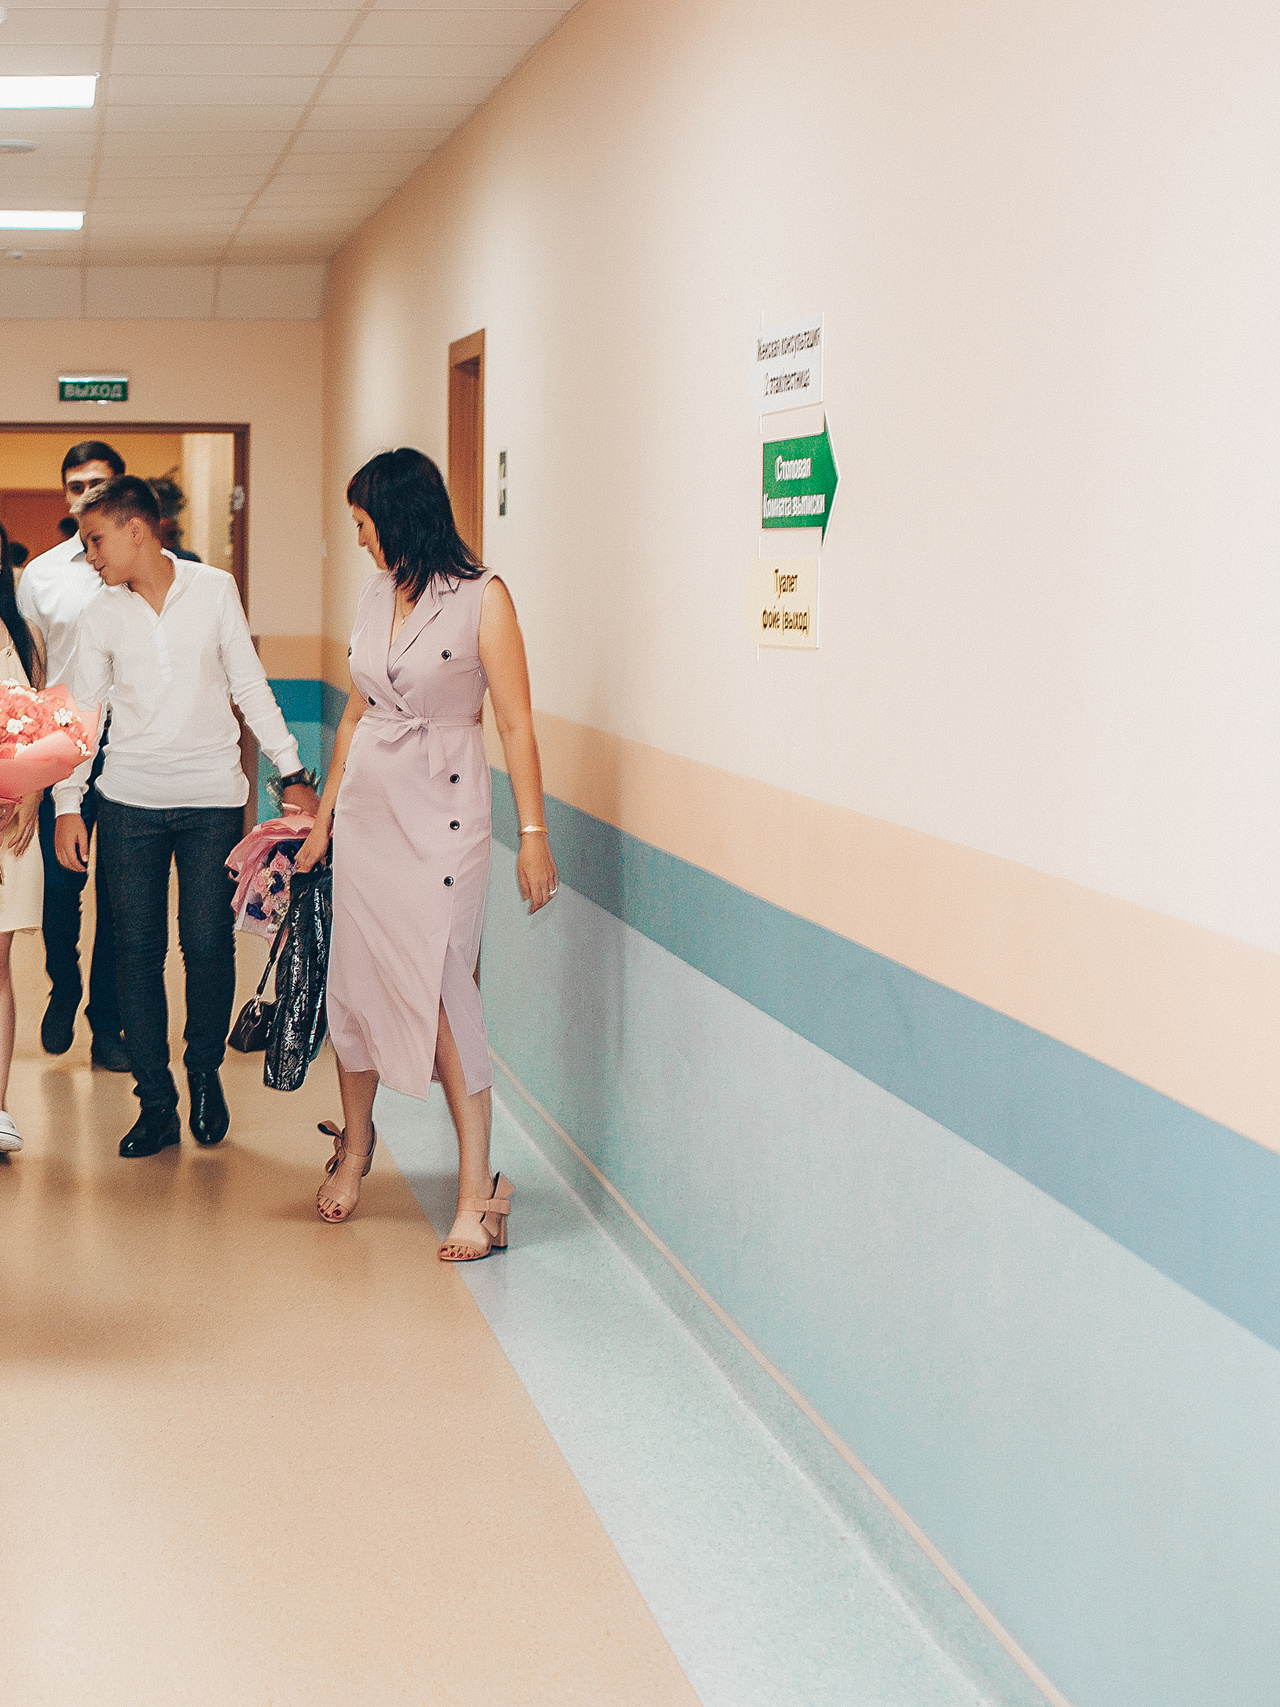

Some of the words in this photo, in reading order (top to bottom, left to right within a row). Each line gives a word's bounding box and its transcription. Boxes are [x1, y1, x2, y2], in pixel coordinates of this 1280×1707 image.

[64, 384, 122, 398] ВЫХОД
[775, 455, 812, 481] Столовая
[763, 493, 792, 519] Комната
[792, 493, 826, 516] выписки
[773, 568, 798, 599] Туалет
[782, 604, 811, 637] (выход)
